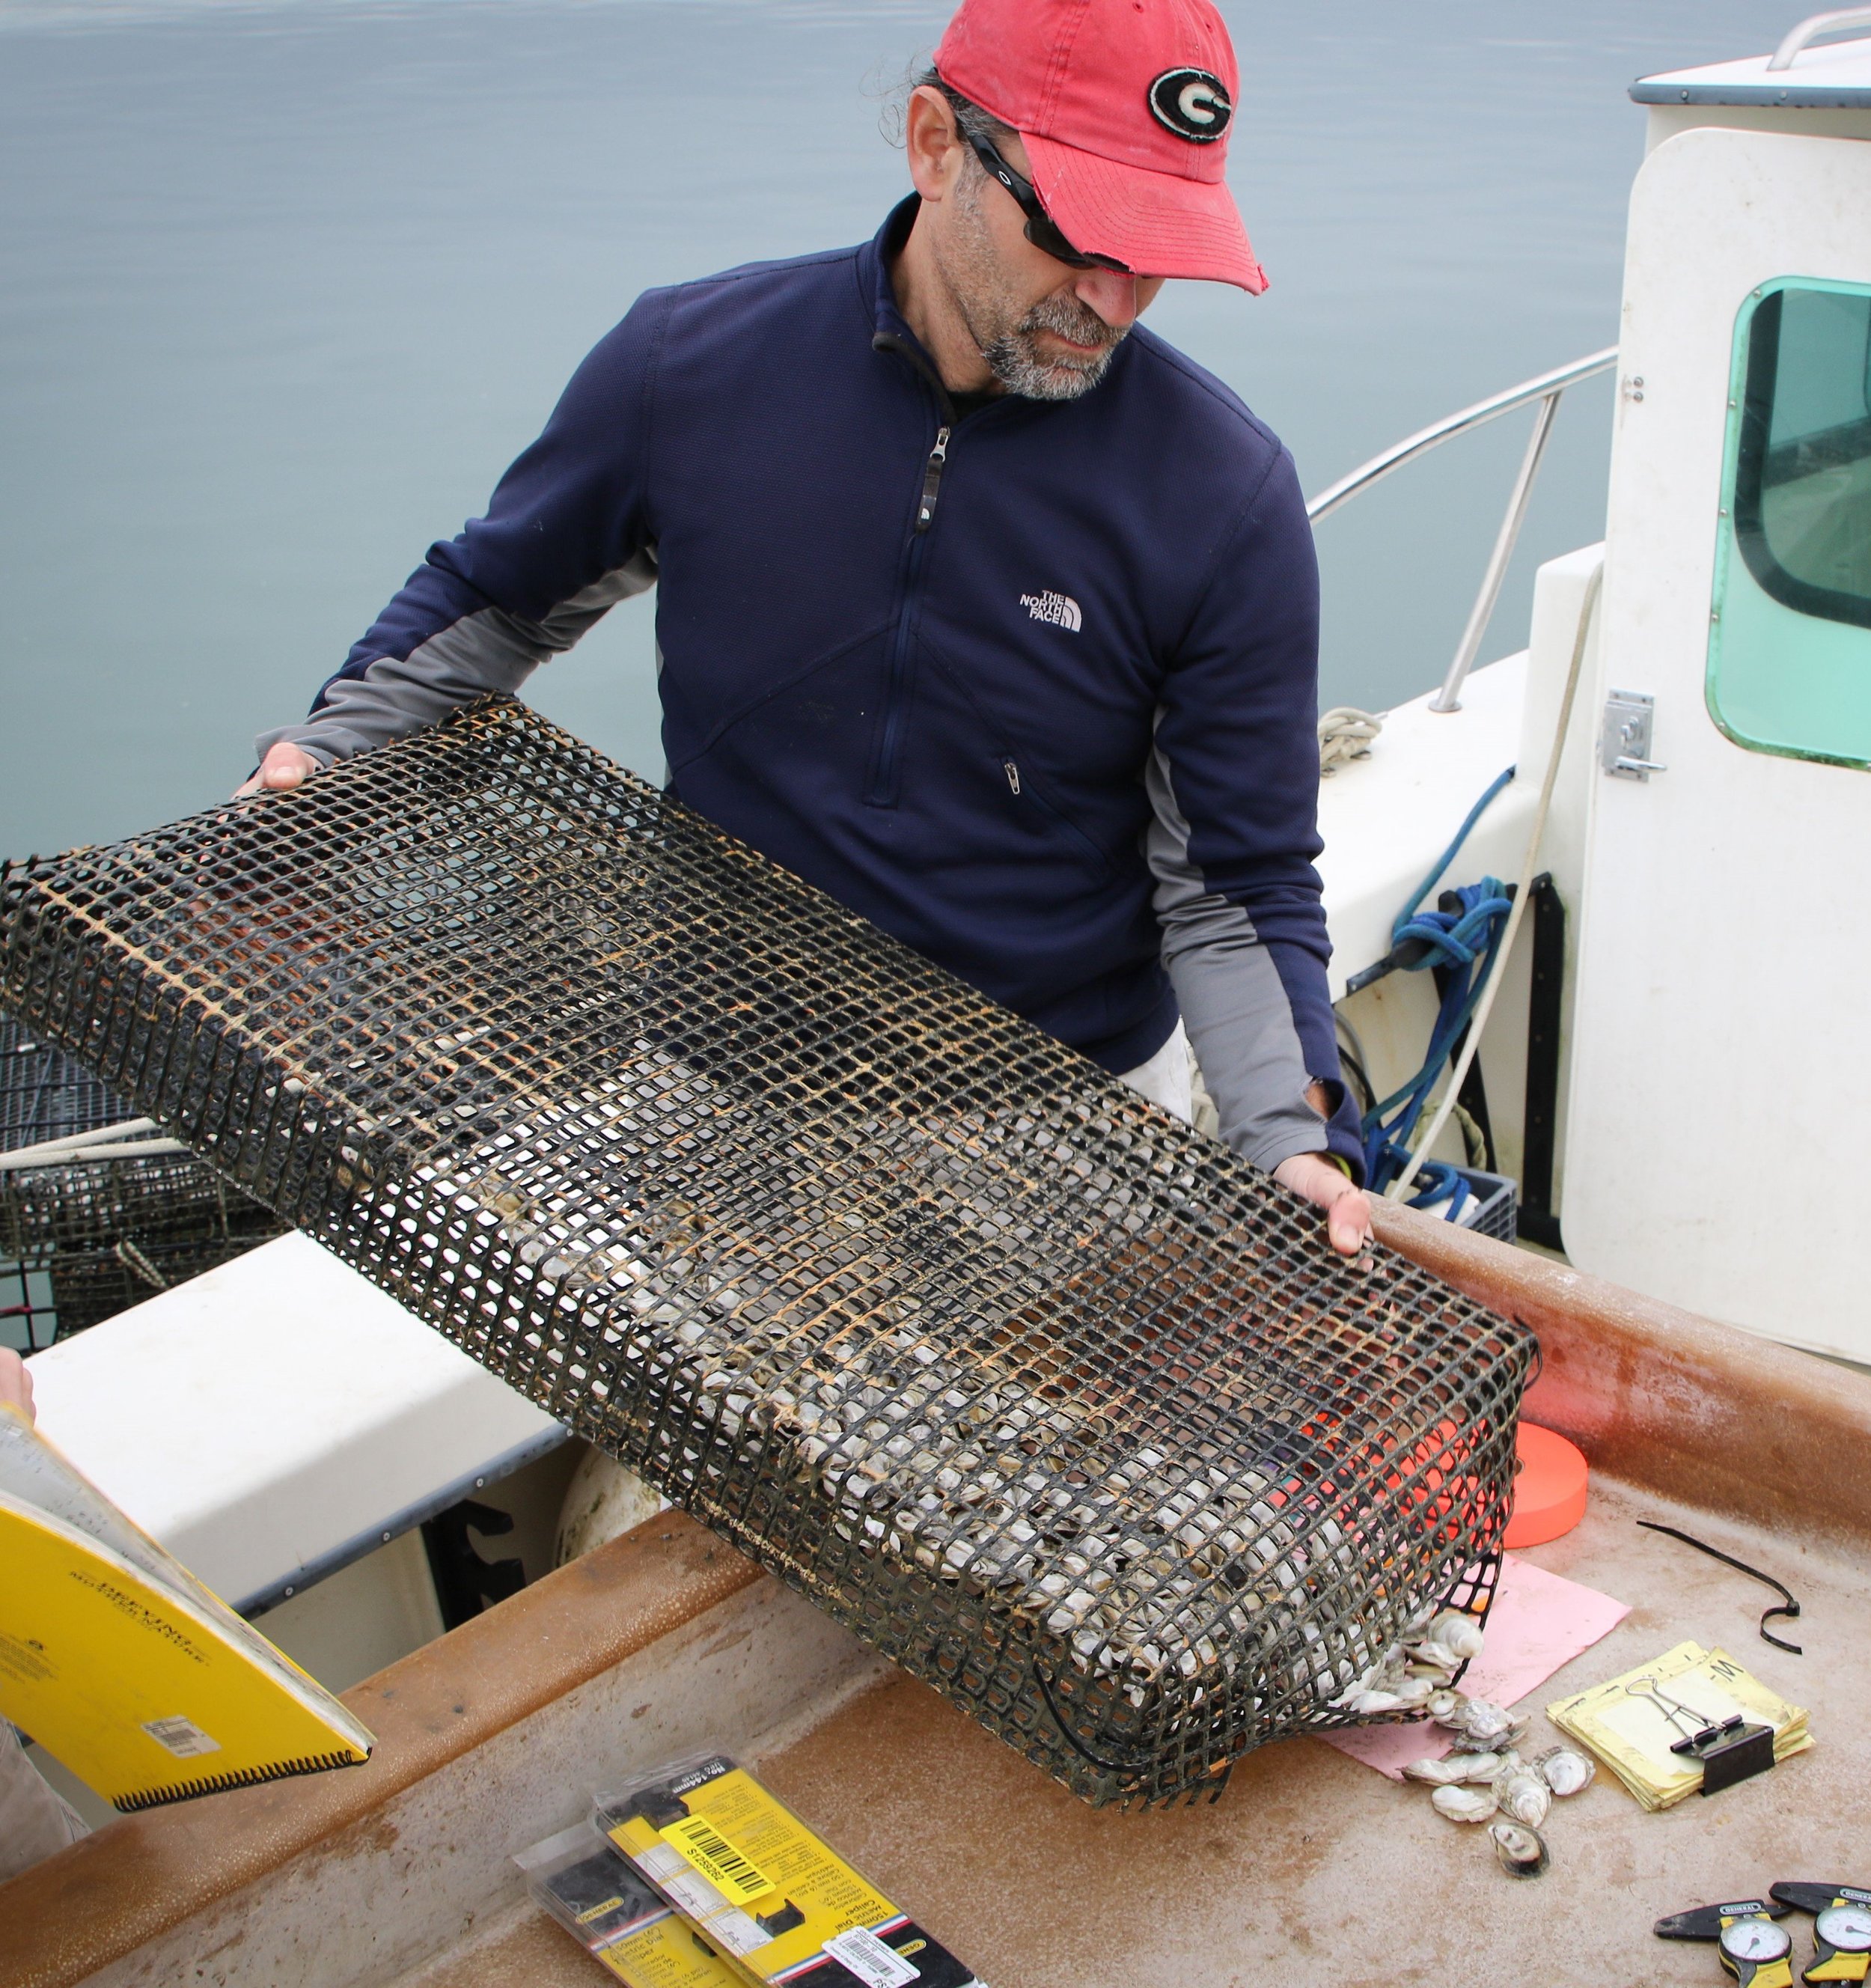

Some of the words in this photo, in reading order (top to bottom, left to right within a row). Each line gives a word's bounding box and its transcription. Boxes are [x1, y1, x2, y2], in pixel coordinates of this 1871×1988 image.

[1019, 594, 1063, 616] NORTH
[1042, 589, 1065, 605] THE
[1029, 607, 1061, 624] FACE
[842, 1898, 877, 1916] Caliper
[1724, 1905, 1755, 1913] GENERAL
[898, 1942, 921, 1956] GENE
